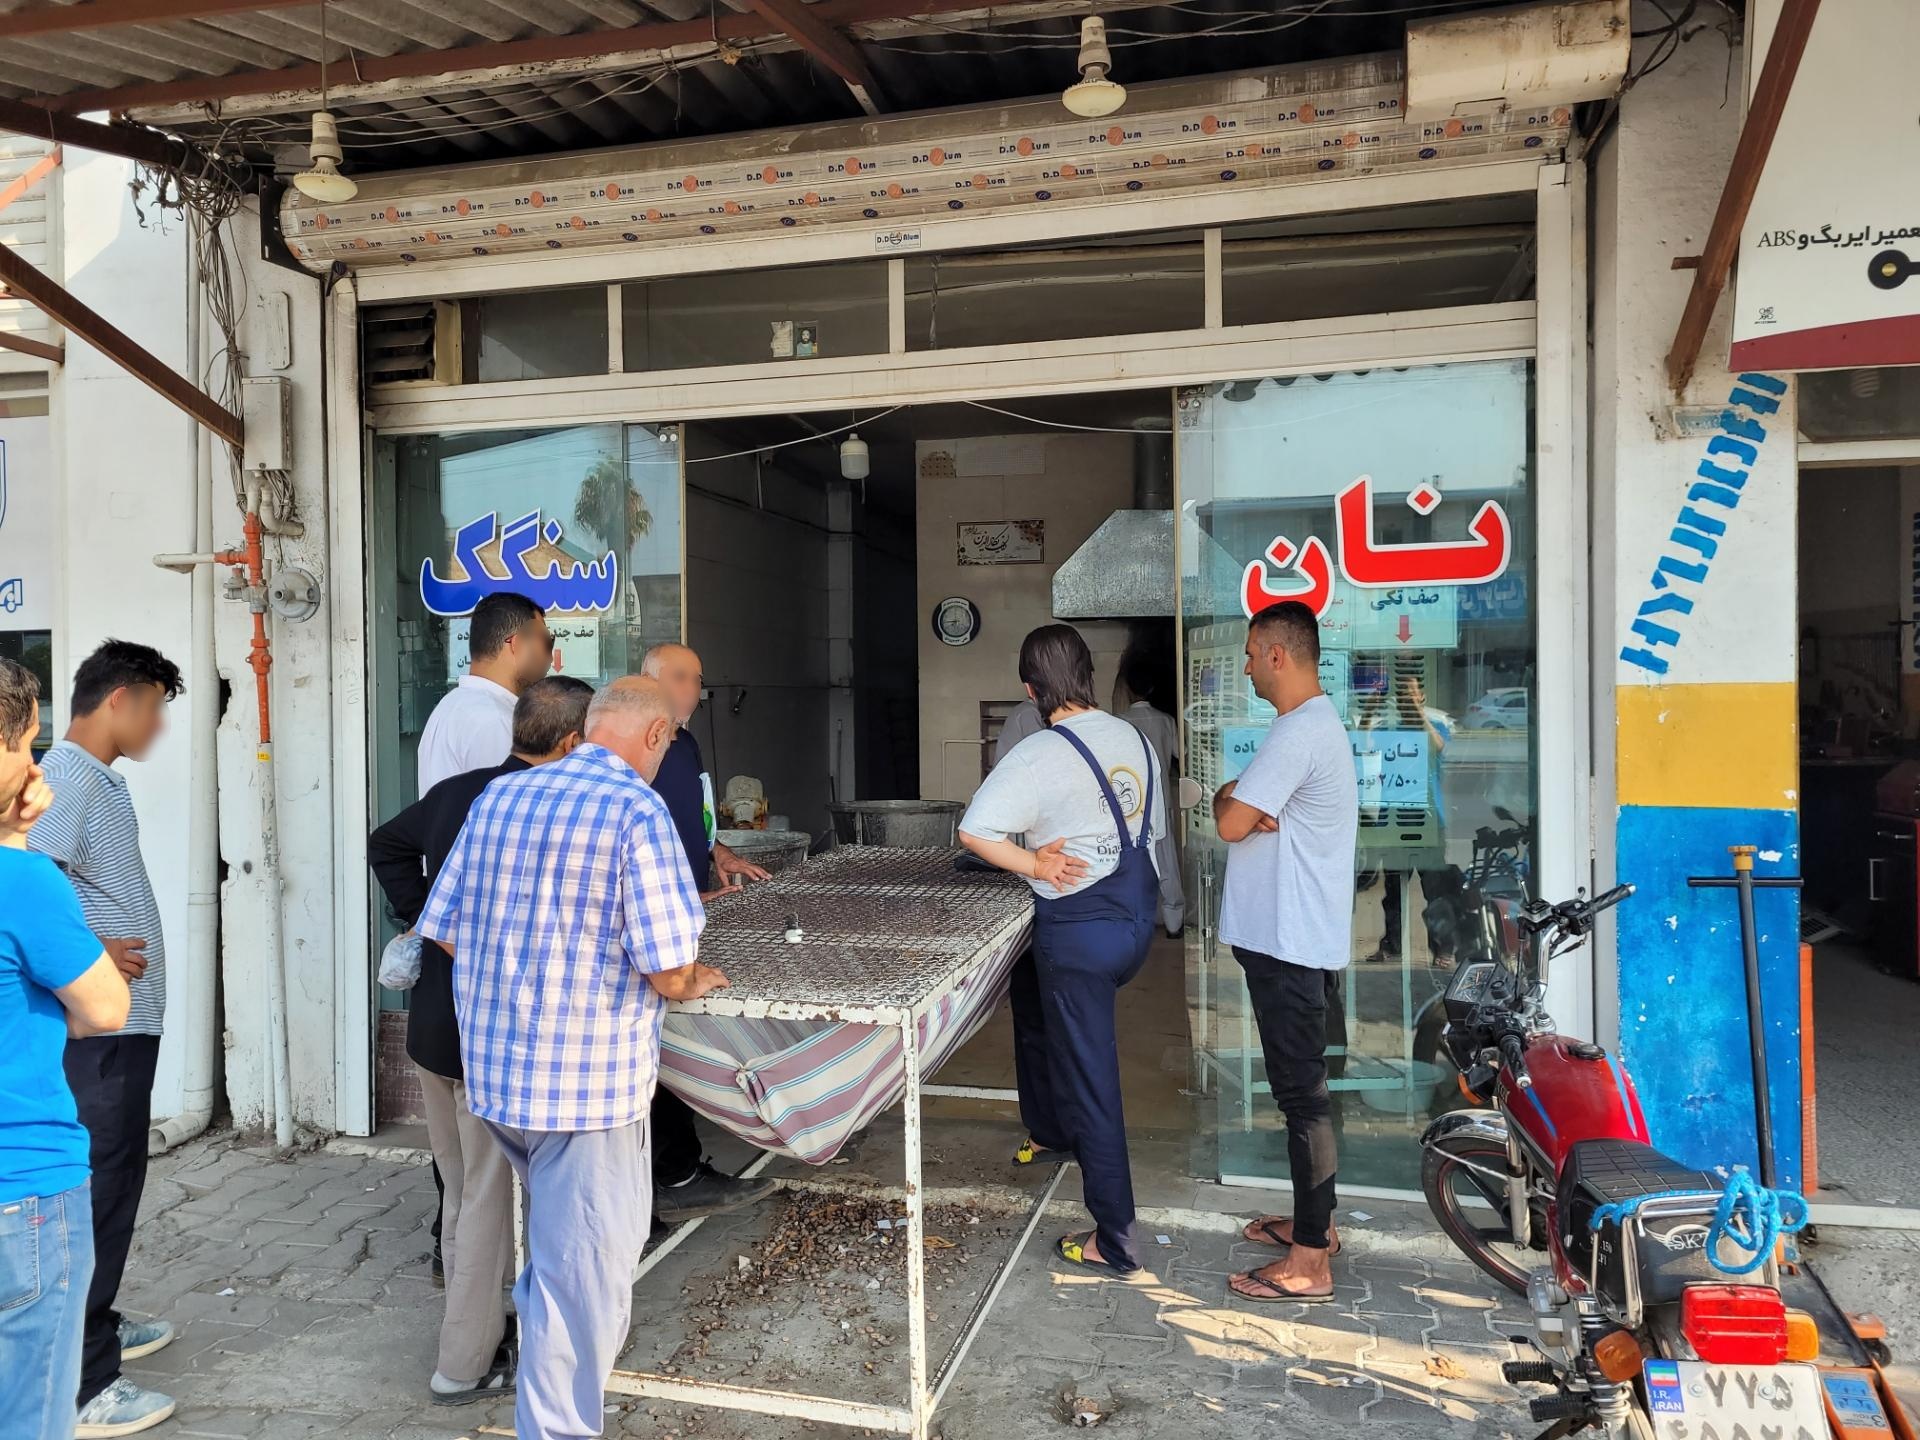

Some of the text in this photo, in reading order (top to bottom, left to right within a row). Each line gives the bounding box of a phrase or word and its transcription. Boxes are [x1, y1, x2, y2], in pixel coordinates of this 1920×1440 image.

[1757, 230, 1796, 248] ABS
[1872, 225, 1920, 246] عمیر
[1240, 474, 1512, 622] نان
[419, 507, 618, 617] سنگک
[1408, 588, 1440, 605] صف
[573, 626, 594, 638] صف
[1384, 743, 1419, 762] نان
[1652, 1390, 1671, 1400] I.R.
[1654, 1401, 1683, 1412] IRAN
